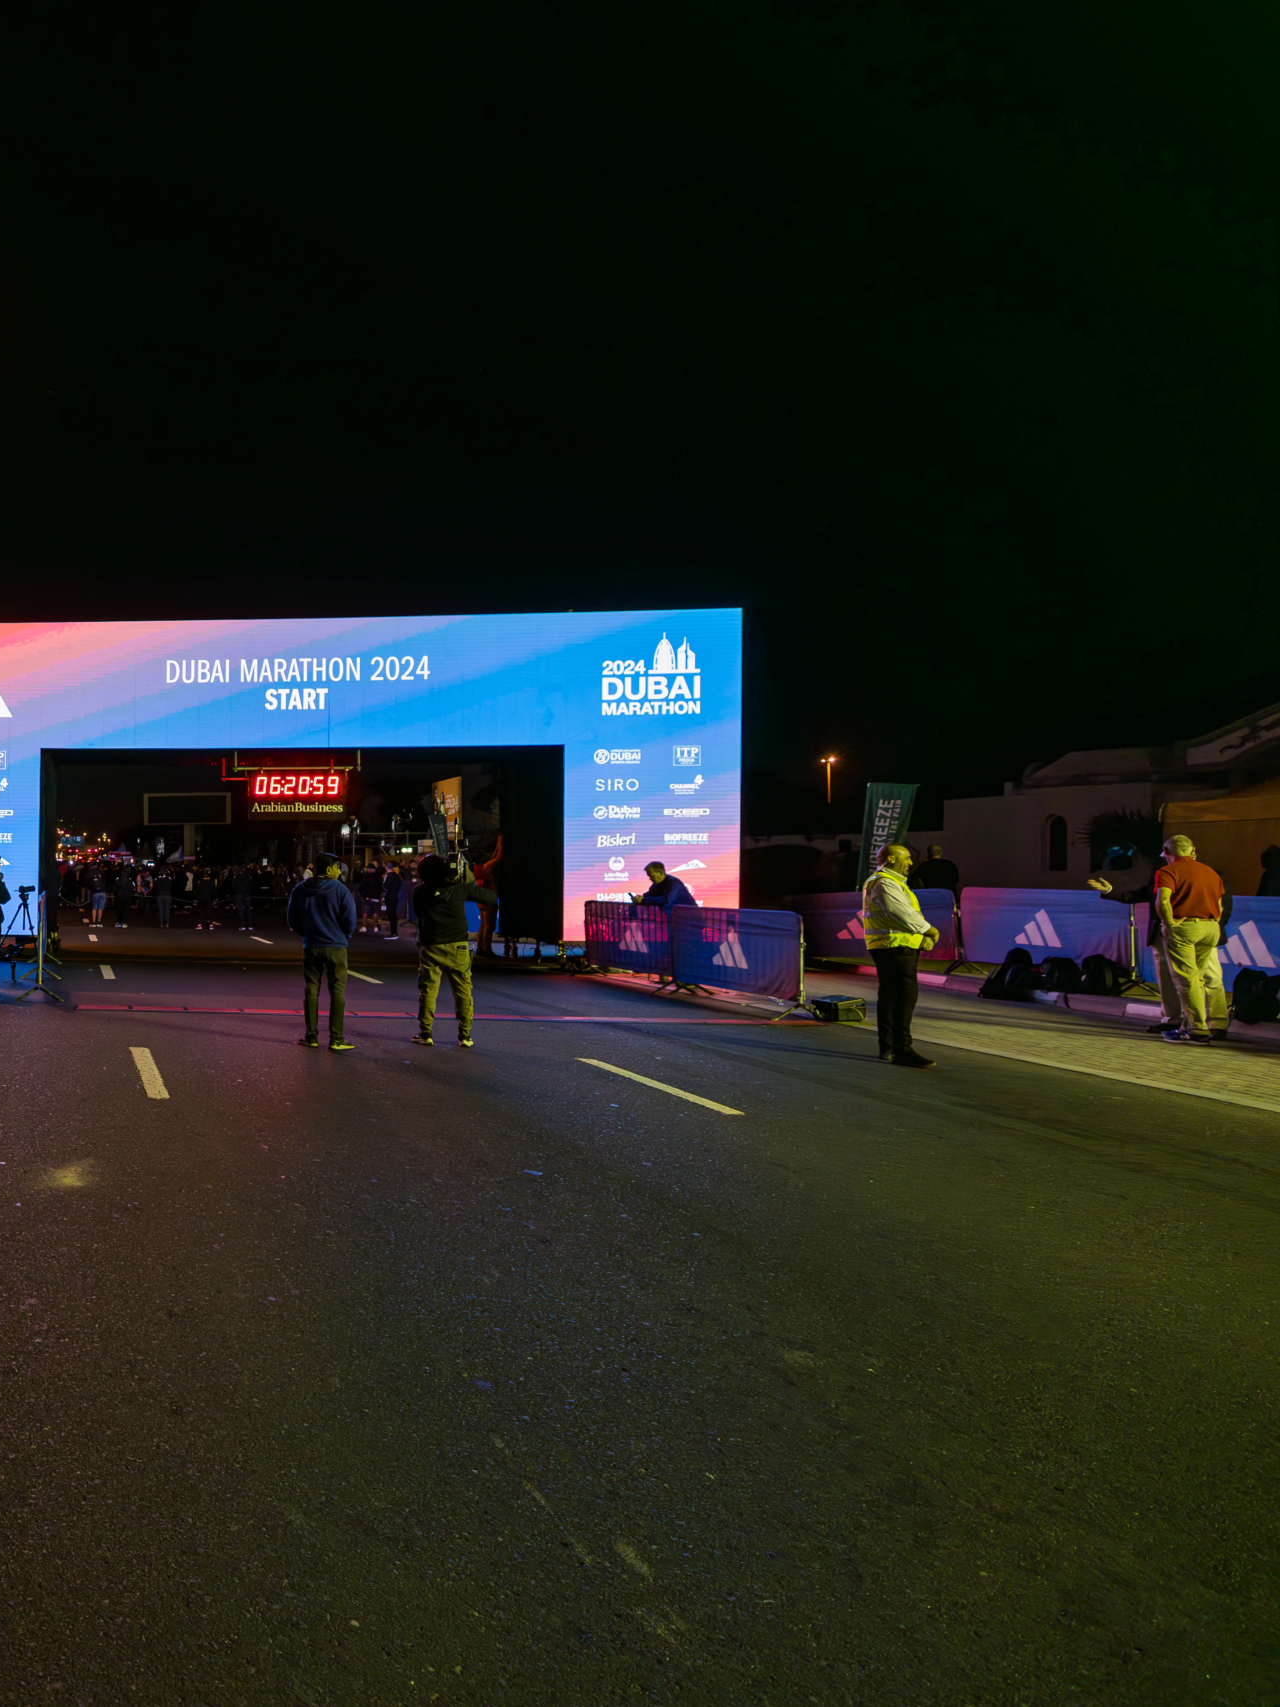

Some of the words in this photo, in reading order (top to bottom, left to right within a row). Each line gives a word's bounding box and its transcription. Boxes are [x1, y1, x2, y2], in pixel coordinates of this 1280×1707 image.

[166, 659, 230, 684] DUBAI
[240, 657, 361, 683] MARATHON
[370, 655, 430, 681] 2024
[602, 659, 646, 675] 2024
[601, 675, 701, 700] DUBAI
[264, 688, 328, 710] START
[601, 700, 701, 716] MARATHON
[610, 752, 641, 760] DUBAI
[676, 747, 699, 758] ITP
[0, 777, 9, 788] 4
[255, 776, 340, 795] 06:20:59
[595, 778, 640, 792] SIRO
[694, 774, 704, 785] 4
[251, 801, 344, 813] ArabianBusiness
[663, 808, 710, 816] EXEED
[597, 832, 636, 848] Bisleri
